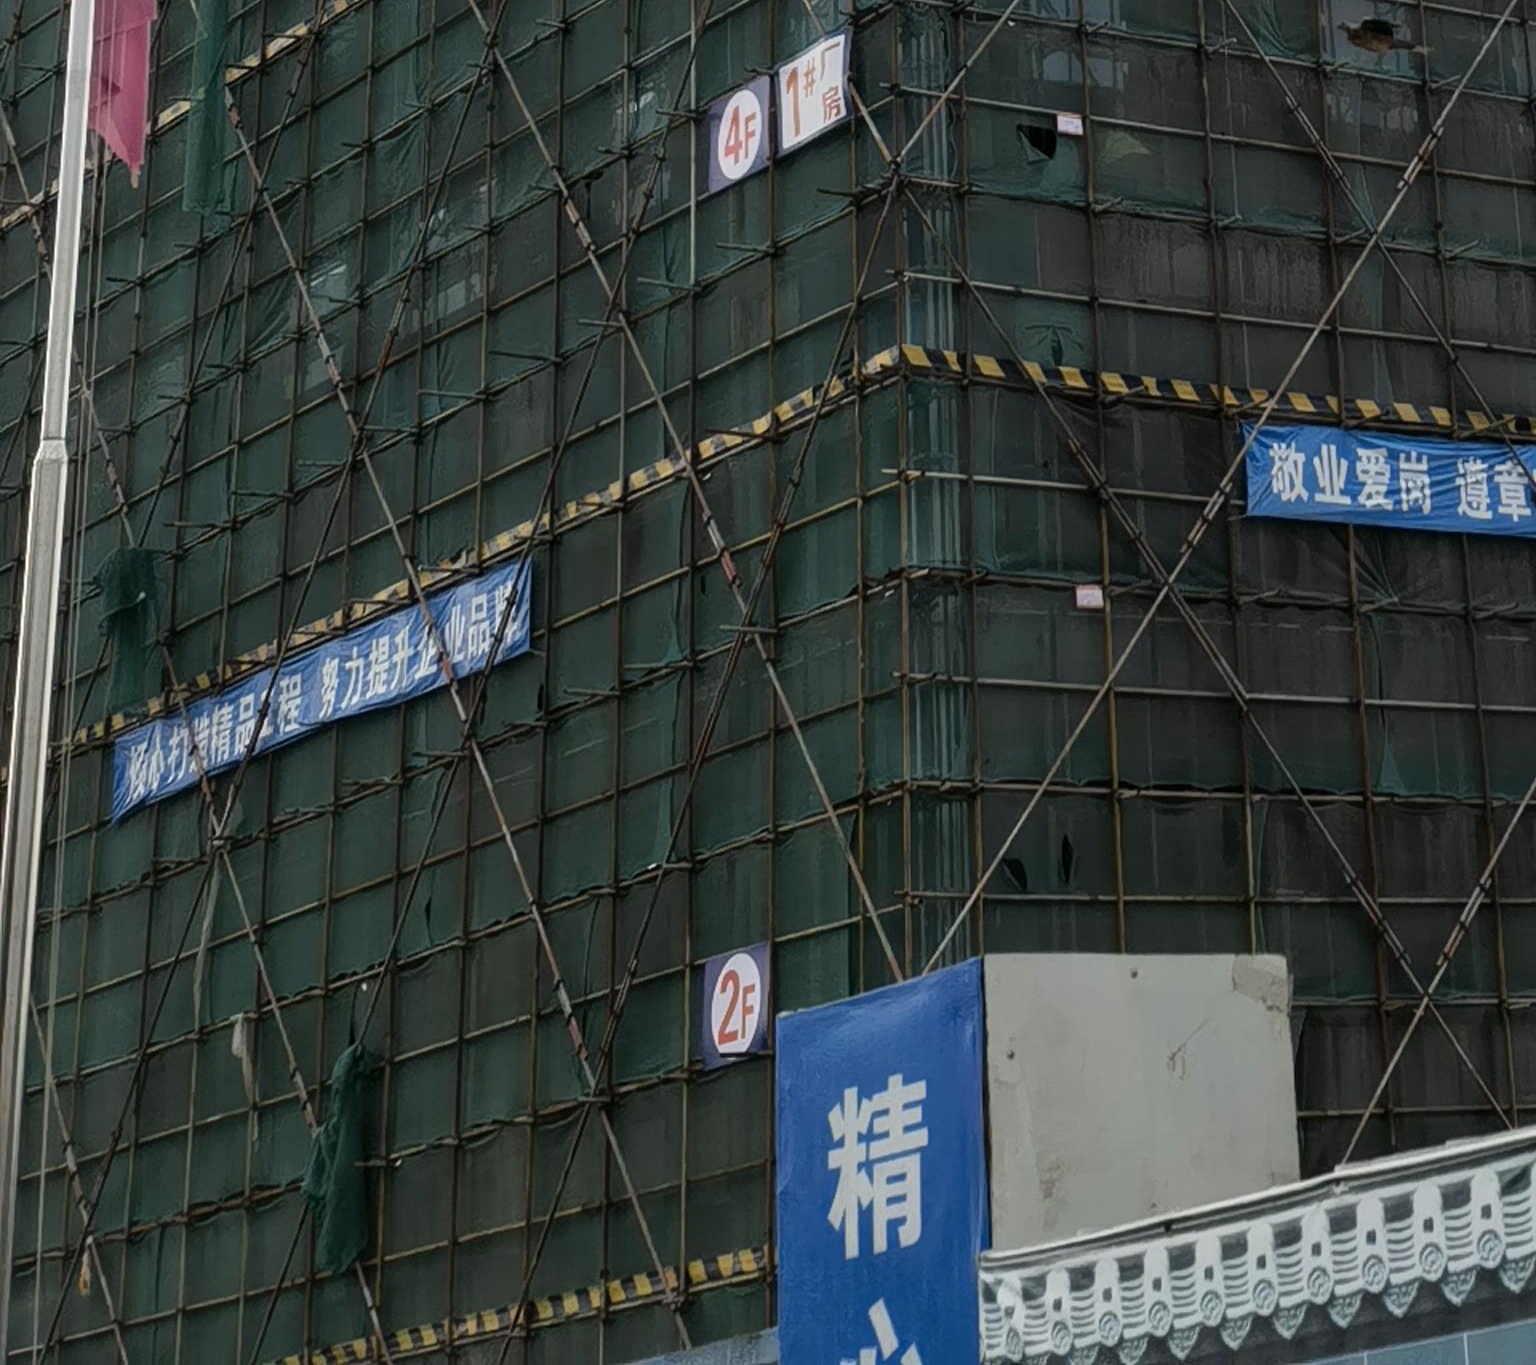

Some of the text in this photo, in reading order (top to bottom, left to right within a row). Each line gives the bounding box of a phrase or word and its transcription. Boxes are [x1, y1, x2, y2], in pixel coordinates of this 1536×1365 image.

[724, 104, 757, 166] 4F
[1269, 440, 1433, 515] 敬业爱岗
[718, 969, 755, 1046] 2F
